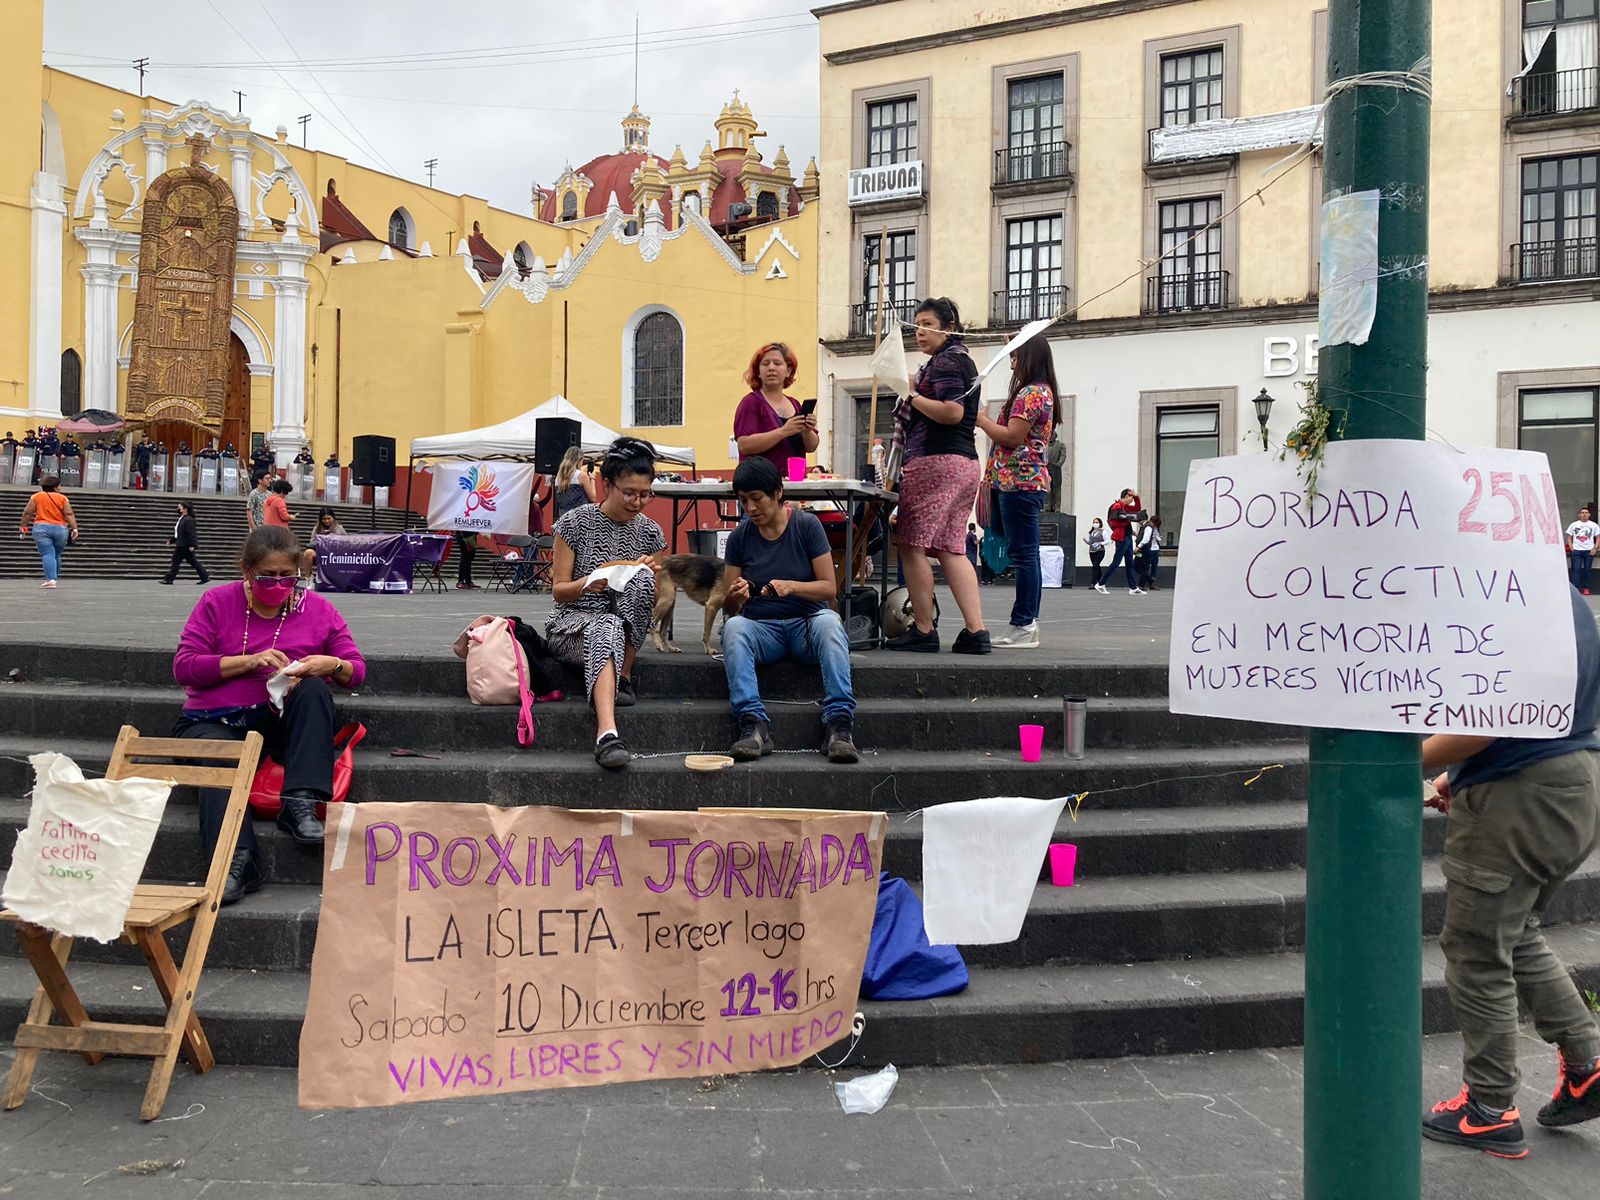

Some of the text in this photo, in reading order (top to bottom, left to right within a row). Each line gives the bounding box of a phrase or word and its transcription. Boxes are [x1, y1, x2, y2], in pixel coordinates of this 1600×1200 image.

[849, 166, 918, 196] TRIBUNA
[454, 517, 492, 527] REMUFEVER
[1196, 475, 1419, 532] BORDADA
[1458, 468, 1561, 545] 25N
[329, 552, 386, 565] feminicidios
[1245, 540, 1527, 606] COLECTIVA
[1191, 621, 1504, 656] EN MEMORIA DE
[1186, 661, 1512, 698] MUJERES VÍCTIMAS DE
[1391, 700, 1572, 733] FEMINICIDIOS
[365, 821, 624, 891] PROXIMA
[644, 832, 874, 899] JORNADA
[405, 913, 464, 963] LA
[637, 911, 733, 952] Tercer
[745, 910, 805, 959] lago
[497, 982, 542, 1034] 10
[561, 983, 705, 1030] Diciembre
[720, 968, 798, 1018] 12-16
[805, 968, 835, 1005] hrs
[388, 1010, 844, 1093] VIVAS, LIBRES Y SIN MIEDO
